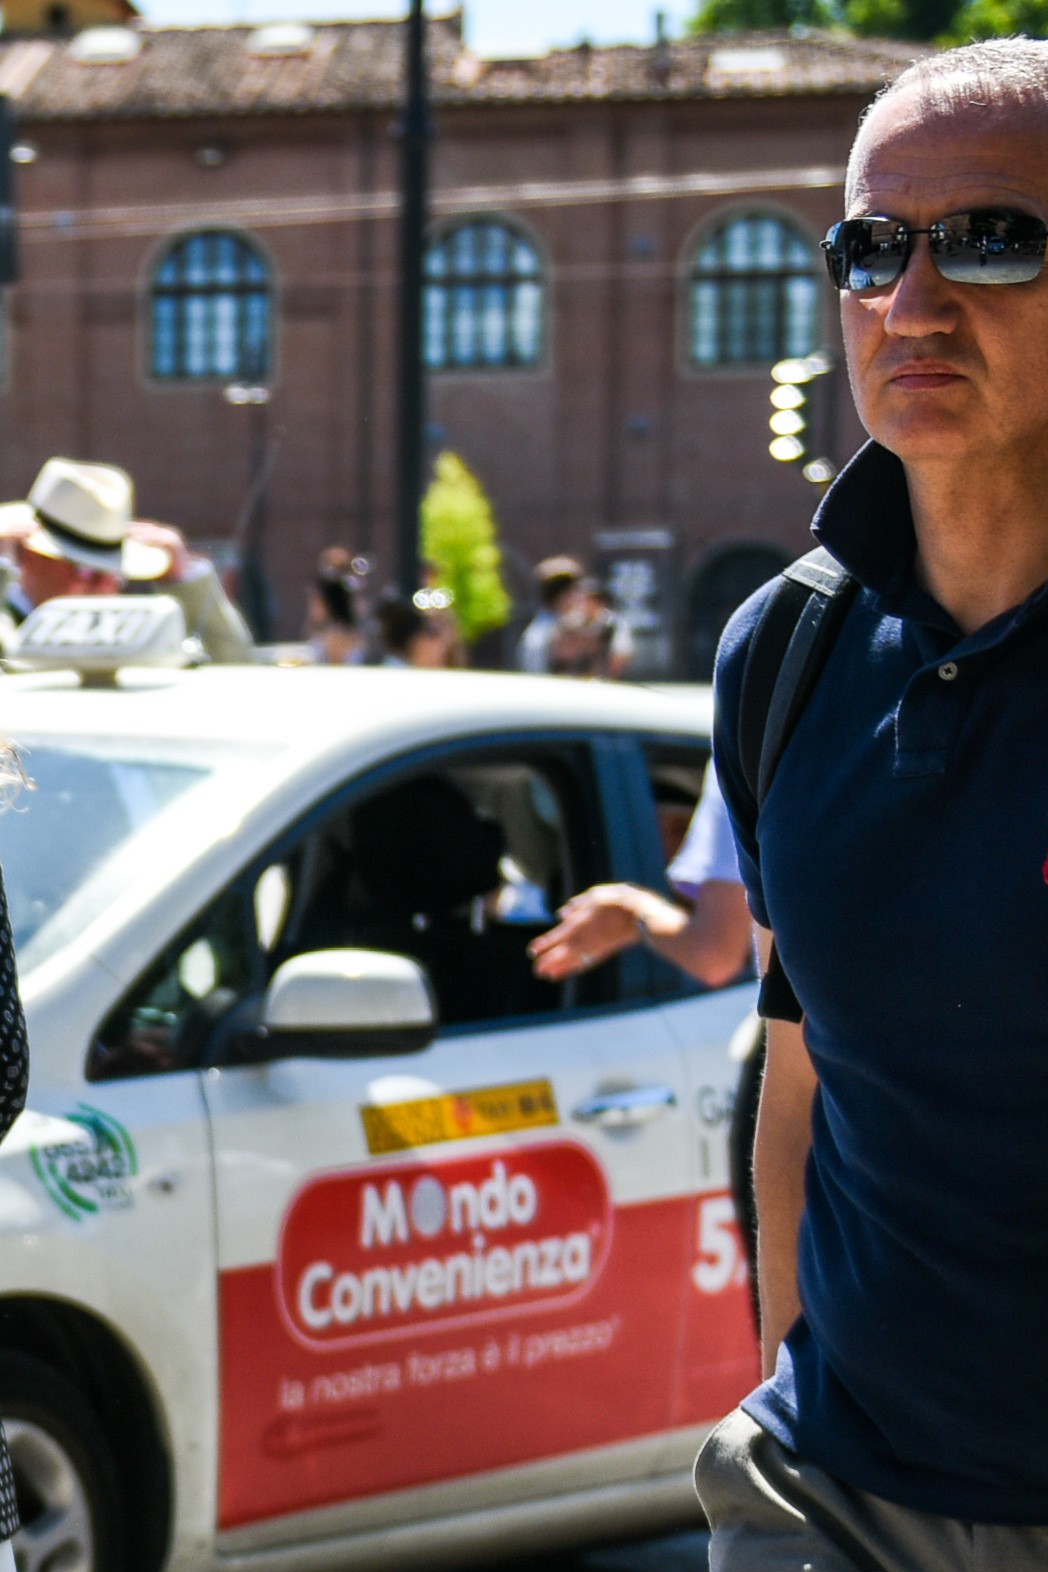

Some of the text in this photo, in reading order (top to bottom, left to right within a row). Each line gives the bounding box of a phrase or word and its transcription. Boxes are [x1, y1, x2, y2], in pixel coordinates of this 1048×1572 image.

[25, 609, 151, 647] TAXI
[359, 1158, 538, 1249] Mondo
[297, 1231, 592, 1330] Convenienza
[280, 1378, 304, 1411] la
[312, 1362, 400, 1402] nostra
[407, 1350, 476, 1386] forza
[523, 1321, 614, 1370] prezzo
